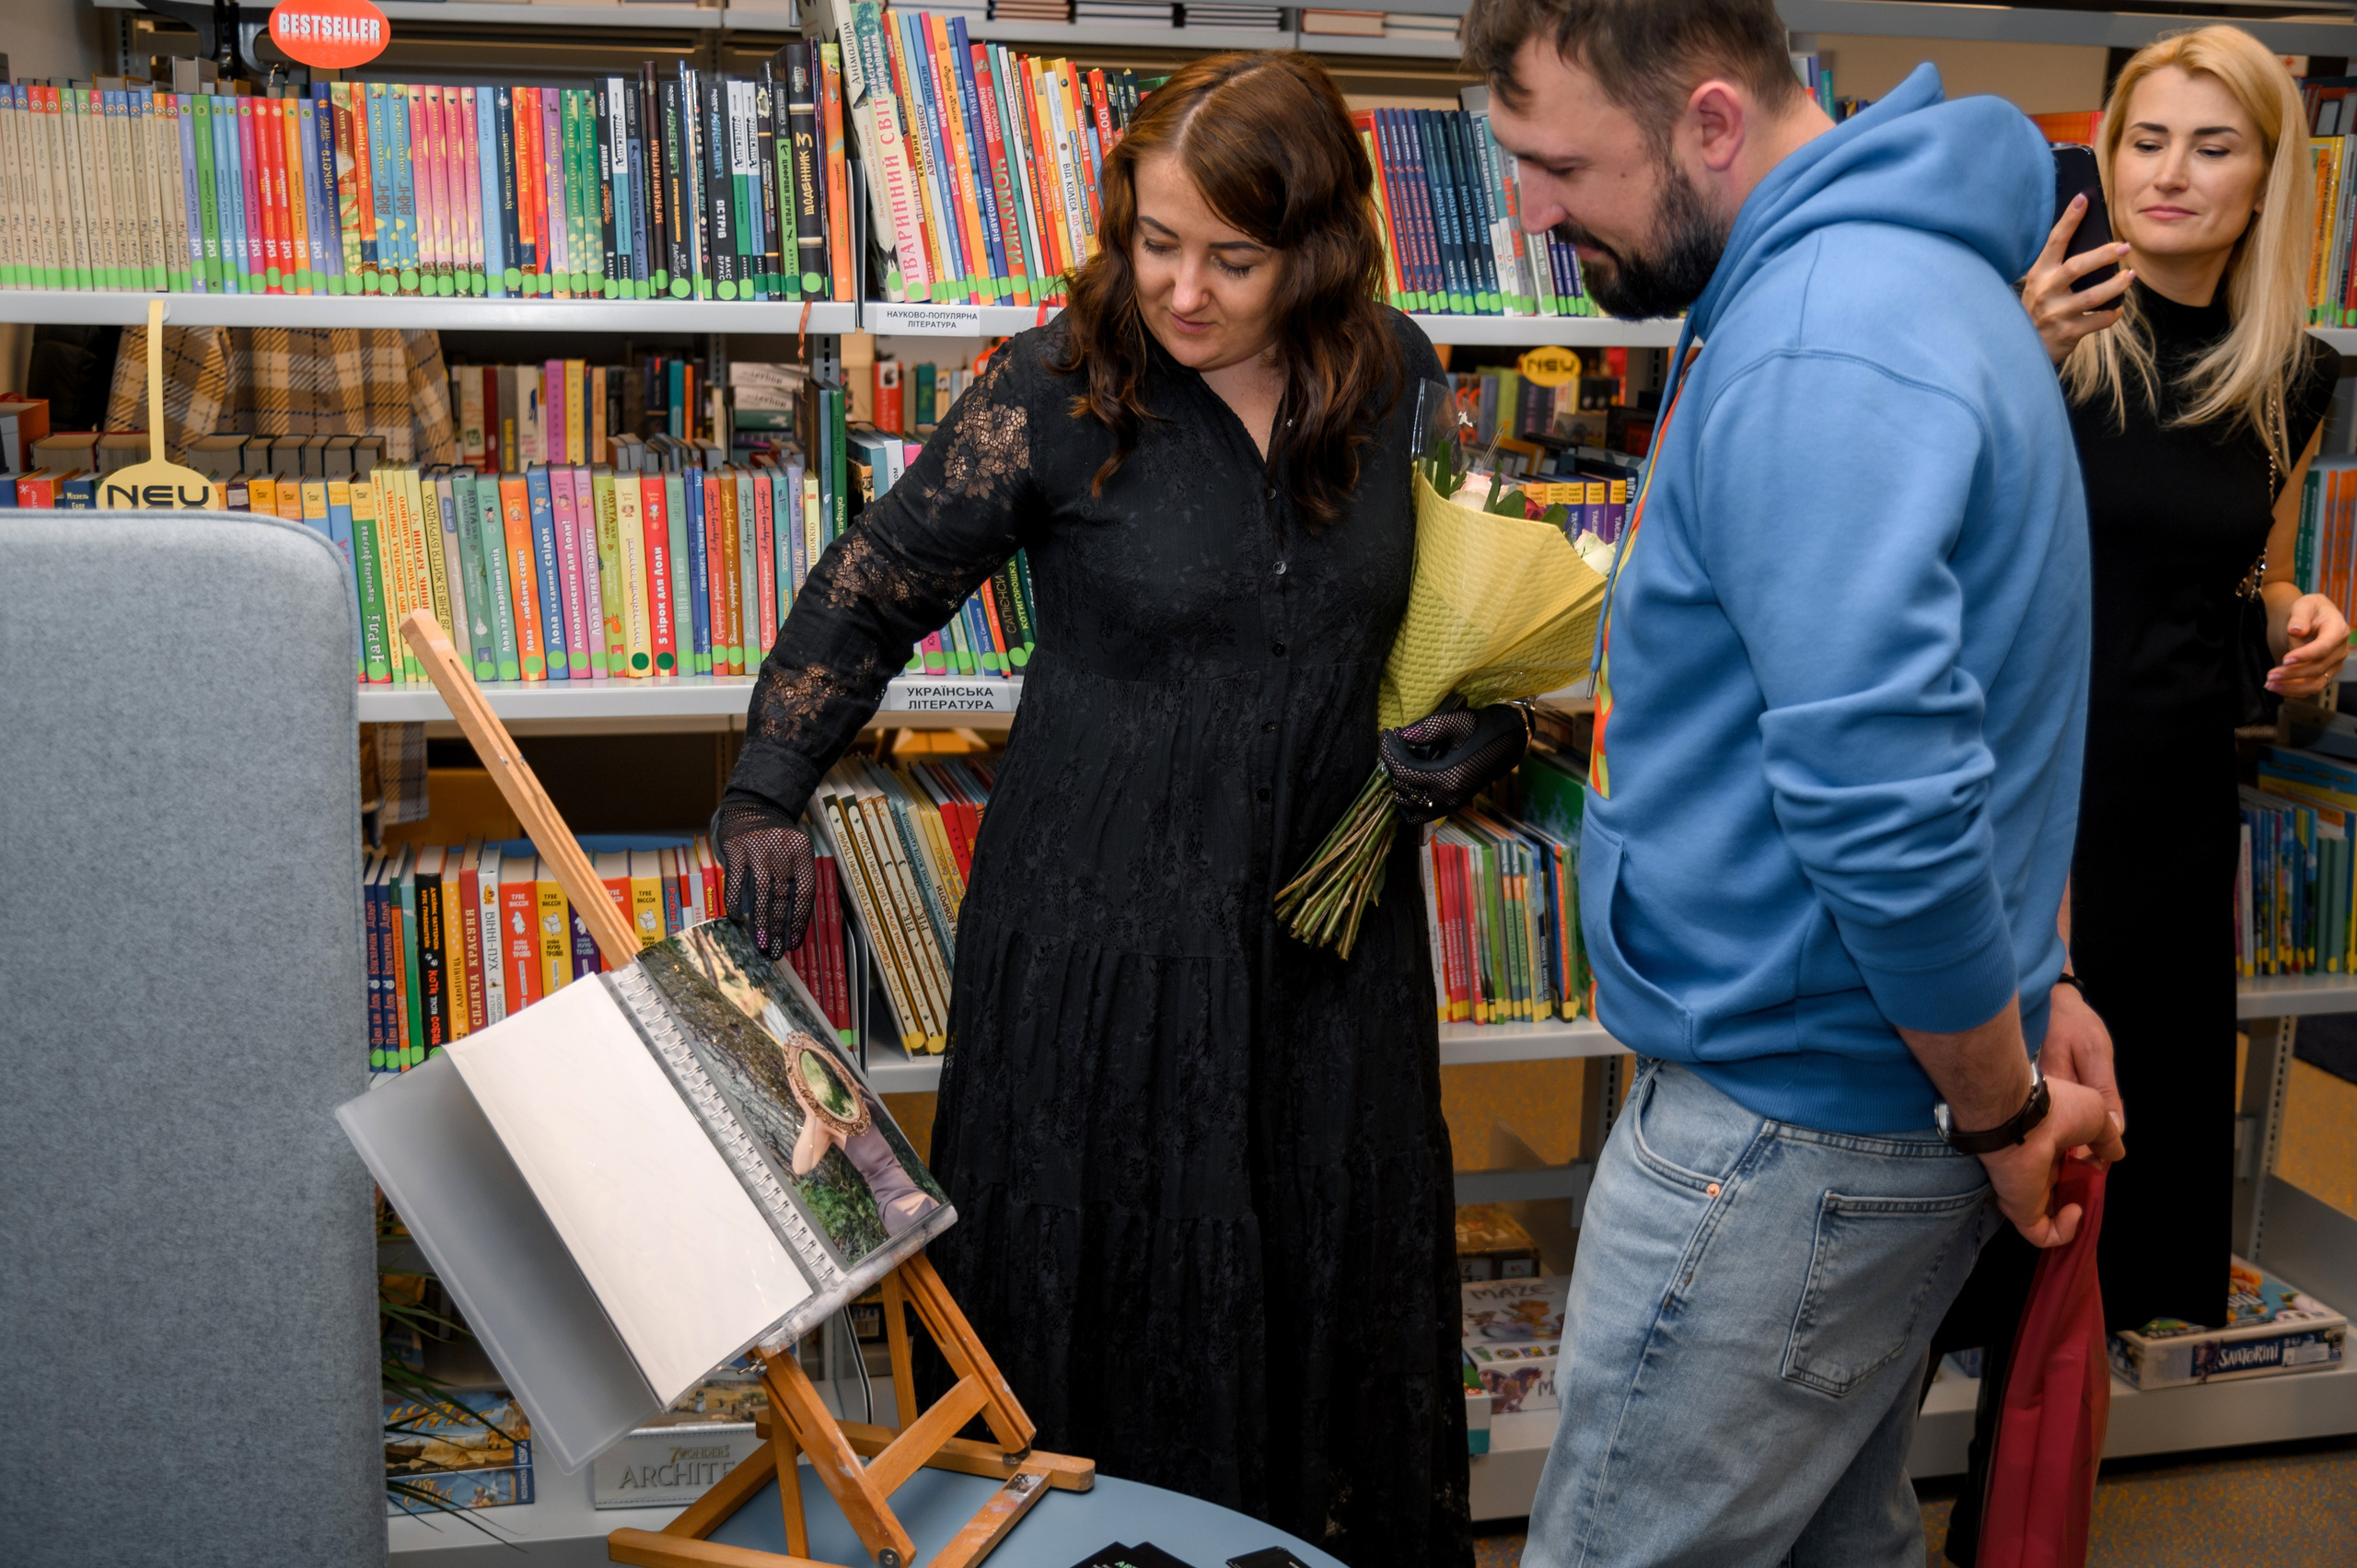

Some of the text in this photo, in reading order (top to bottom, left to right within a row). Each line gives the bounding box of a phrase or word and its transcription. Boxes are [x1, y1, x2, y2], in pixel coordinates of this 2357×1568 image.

[278, 13, 380, 40] BESTSELLER
[842, 21, 861, 86] Анімаліум
[921, 65, 938, 138] НЕНУДНА НАУКА
[980, 87, 994, 143] ЕНЦИКЛОПЕДІЯ
[986, 86, 1001, 141] ІЛЮСТРОВАНА
[1098, 107, 1109, 128] 100
[613, 113, 625, 167] MINECRAFT
[732, 116, 743, 168] MINECRAFT
[747, 117, 758, 168] MINECRAFT
[917, 104, 935, 176] АЗБУКА БІЗНЕСУ
[782, 159, 790, 193] ЦИФРОВА
[795, 132, 814, 215] ЩОДЕННИК 3
[957, 144, 973, 205] ЯК ЧОМУ
[966, 80, 1001, 243] ДИТЯЧА ЕНЦИКЛОПЕДІЯ ДИНОЗАВРІВ
[1062, 163, 1073, 179] ВІД
[1476, 123, 1496, 222] ІСТОРІЯ ДОСЛІДЖЕННЯ КОСМОСУ
[652, 140, 663, 224] ЗАГУБЛЕНІ ЛЕГЕНДИ
[874, 96, 920, 283] ТВАРИННИЙ СВІТ
[1066, 181, 1077, 212] КОЛЕСА
[1461, 185, 1471, 214] ІСТОРІЇ
[715, 200, 726, 238] ОСТРІВ
[993, 158, 1023, 266] ЧОМУЧКИ
[1029, 168, 1038, 192] ВЕЛИКІ
[1037, 212, 1046, 236] КІШКИ
[1435, 188, 1446, 215] ІСТОРІЇ
[1502, 178, 1525, 258] ПЕС МАНІ
[1441, 217, 1450, 245] ЛЕСЕВІ
[1467, 215, 1476, 242] ЛЕСЕВІ
[718, 256, 726, 281] БРУКС
[1399, 236, 1409, 266] ДОМІВКА
[1430, 236, 1439, 265] ДОМІВКА
[887, 310, 978, 320] НАУКОВО-ПОПУЛЯРНА
[908, 319, 957, 330] ЛІТЕРАТУРА
[1527, 358, 1575, 372] NEU
[107, 485, 210, 506] NEU
[425, 494, 440, 548] БУРУНДУКА
[387, 490, 407, 613] ПРО ПОРОСЯТКА РОБІНЗОНА
[399, 496, 417, 591] РУДОГО КВАШЕНОГО
[541, 527, 552, 566] свідок
[653, 547, 664, 575] Лоли
[433, 551, 446, 583] ЖИТТЯ
[562, 520, 583, 649] Аплодисменти для Лоли!
[585, 528, 601, 635] Лола шукає подругу
[492, 548, 511, 652] Лола та аварійний вхід
[517, 550, 534, 651] Лола любляче серце
[656, 577, 666, 598] для
[994, 575, 1016, 633] САПІЄНСИ
[1009, 561, 1028, 629] КОТИГОРОШКА
[437, 595, 449, 617] ДНІВ
[550, 604, 557, 612] та
[656, 601, 668, 633] зірок
[440, 619, 449, 630] 28
[550, 616, 560, 645] Лола
[907, 684, 993, 698] УКРАЇНСЬКА
[908, 699, 994, 711] ЛІТЕРАТУРА
[668, 887, 679, 921] Робін
[838, 830, 892, 969] НЕЗВИЧАЙНА ДРУЖБА РОСЛИН ТВАРИН
[936, 885, 955, 923] ДОБРОТИ
[904, 912, 915, 933] РІК
[485, 912, 498, 971] ВІННІ-ПУХ
[428, 970, 438, 994] КОТИ
[466, 909, 482, 1026] СПЛЯЧА КРАСУНЯ
[431, 1016, 440, 1045] СОБАК
[1470, 1283, 1556, 1300] MAZE
[620, 1461, 735, 1489] ARCHITE
